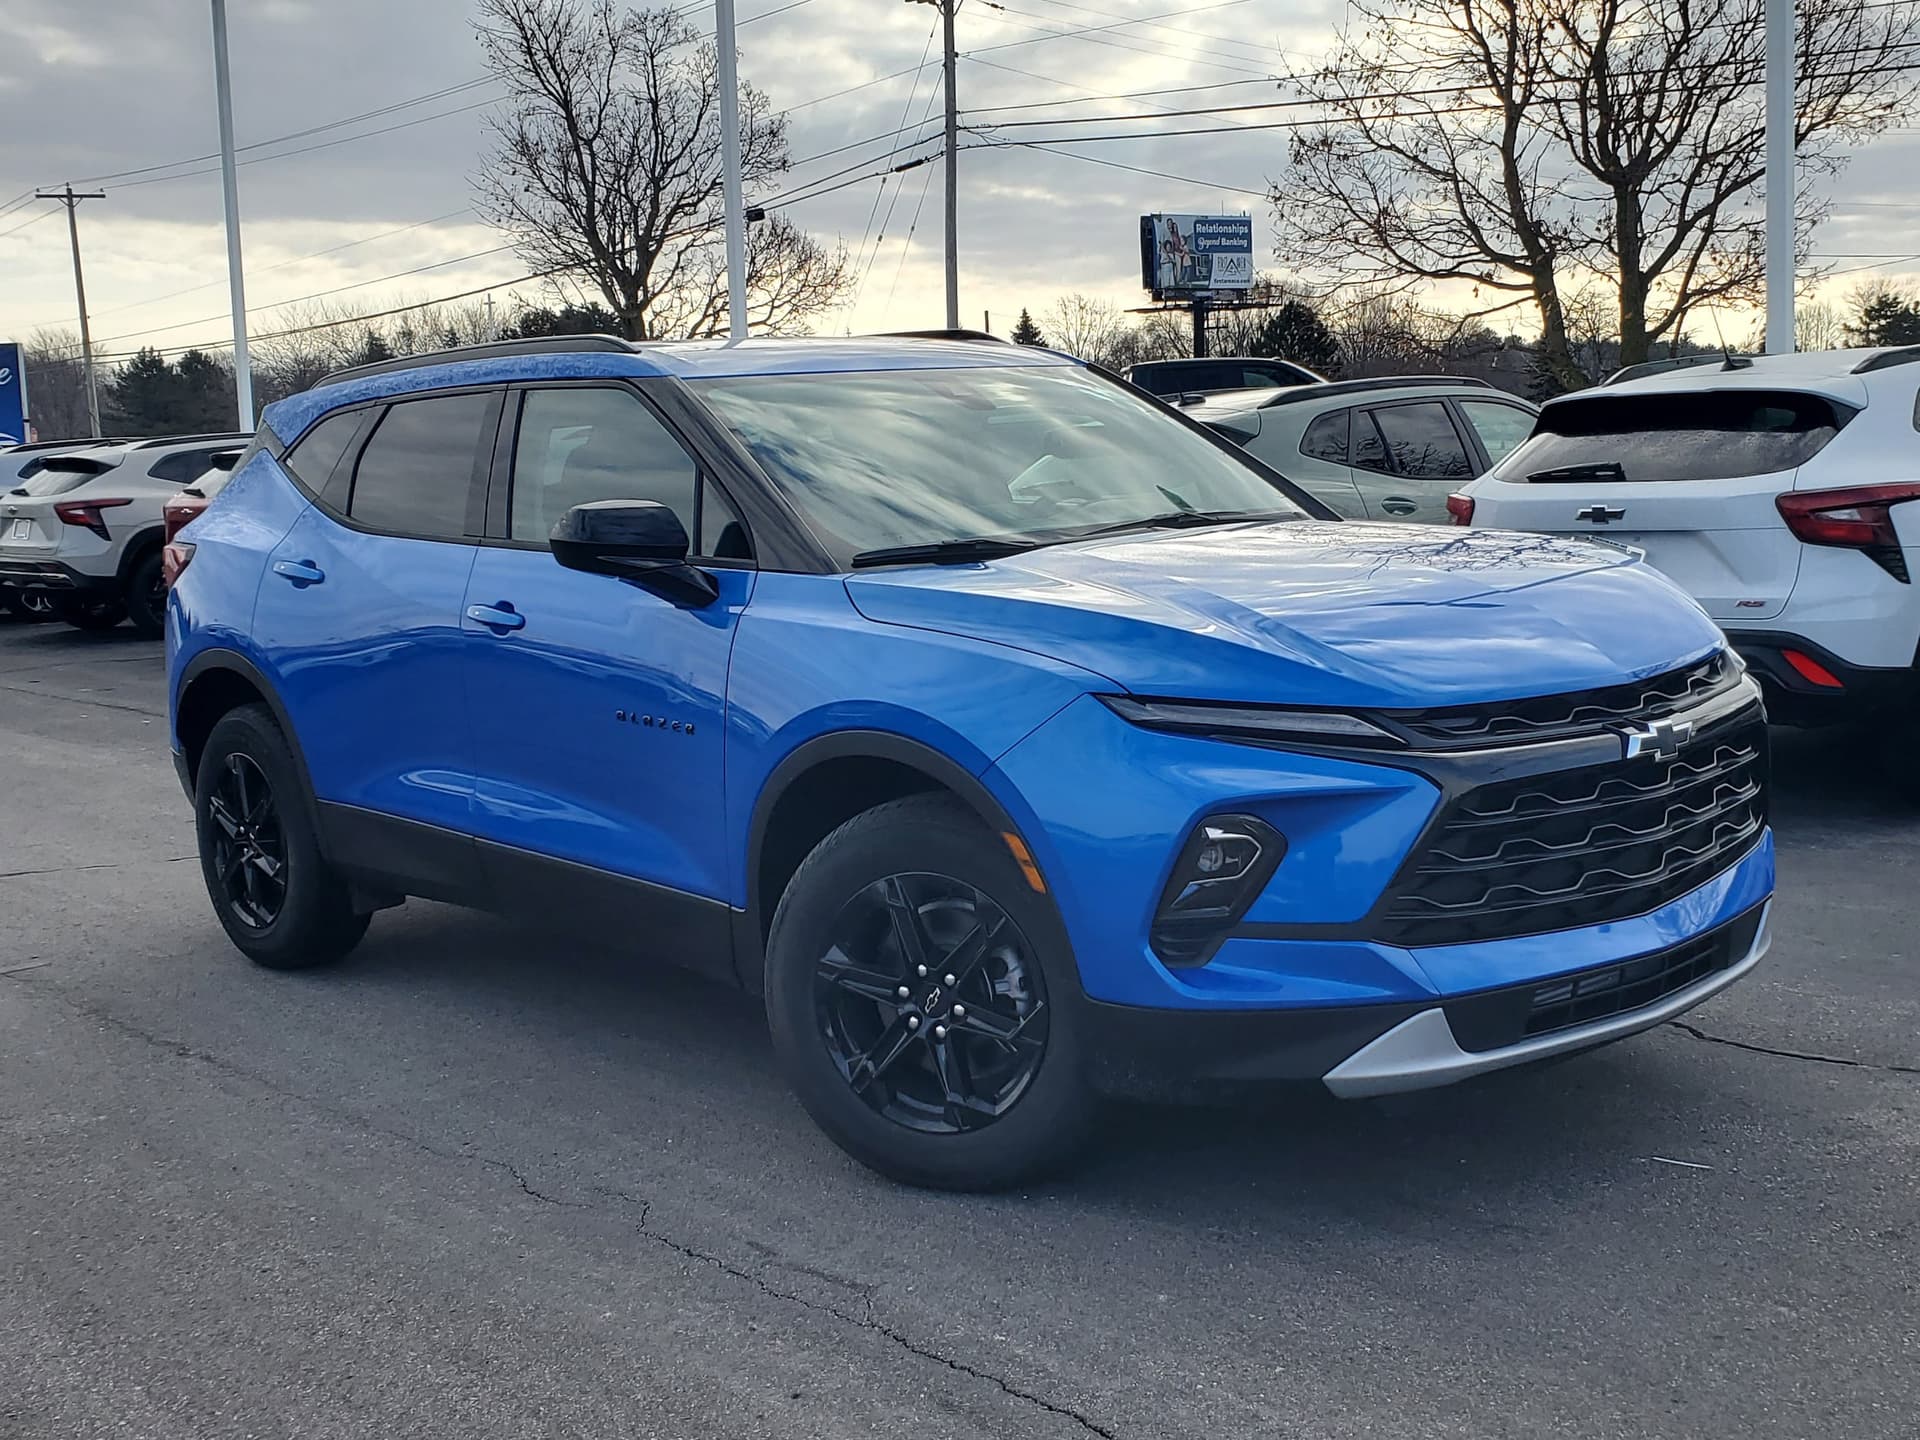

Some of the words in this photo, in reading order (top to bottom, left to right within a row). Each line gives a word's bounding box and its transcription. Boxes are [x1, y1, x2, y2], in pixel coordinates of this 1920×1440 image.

[1196, 223, 1249, 235] Relationships
[1221, 237, 1247, 247] Banking
[616, 710, 695, 735] BLAZER
